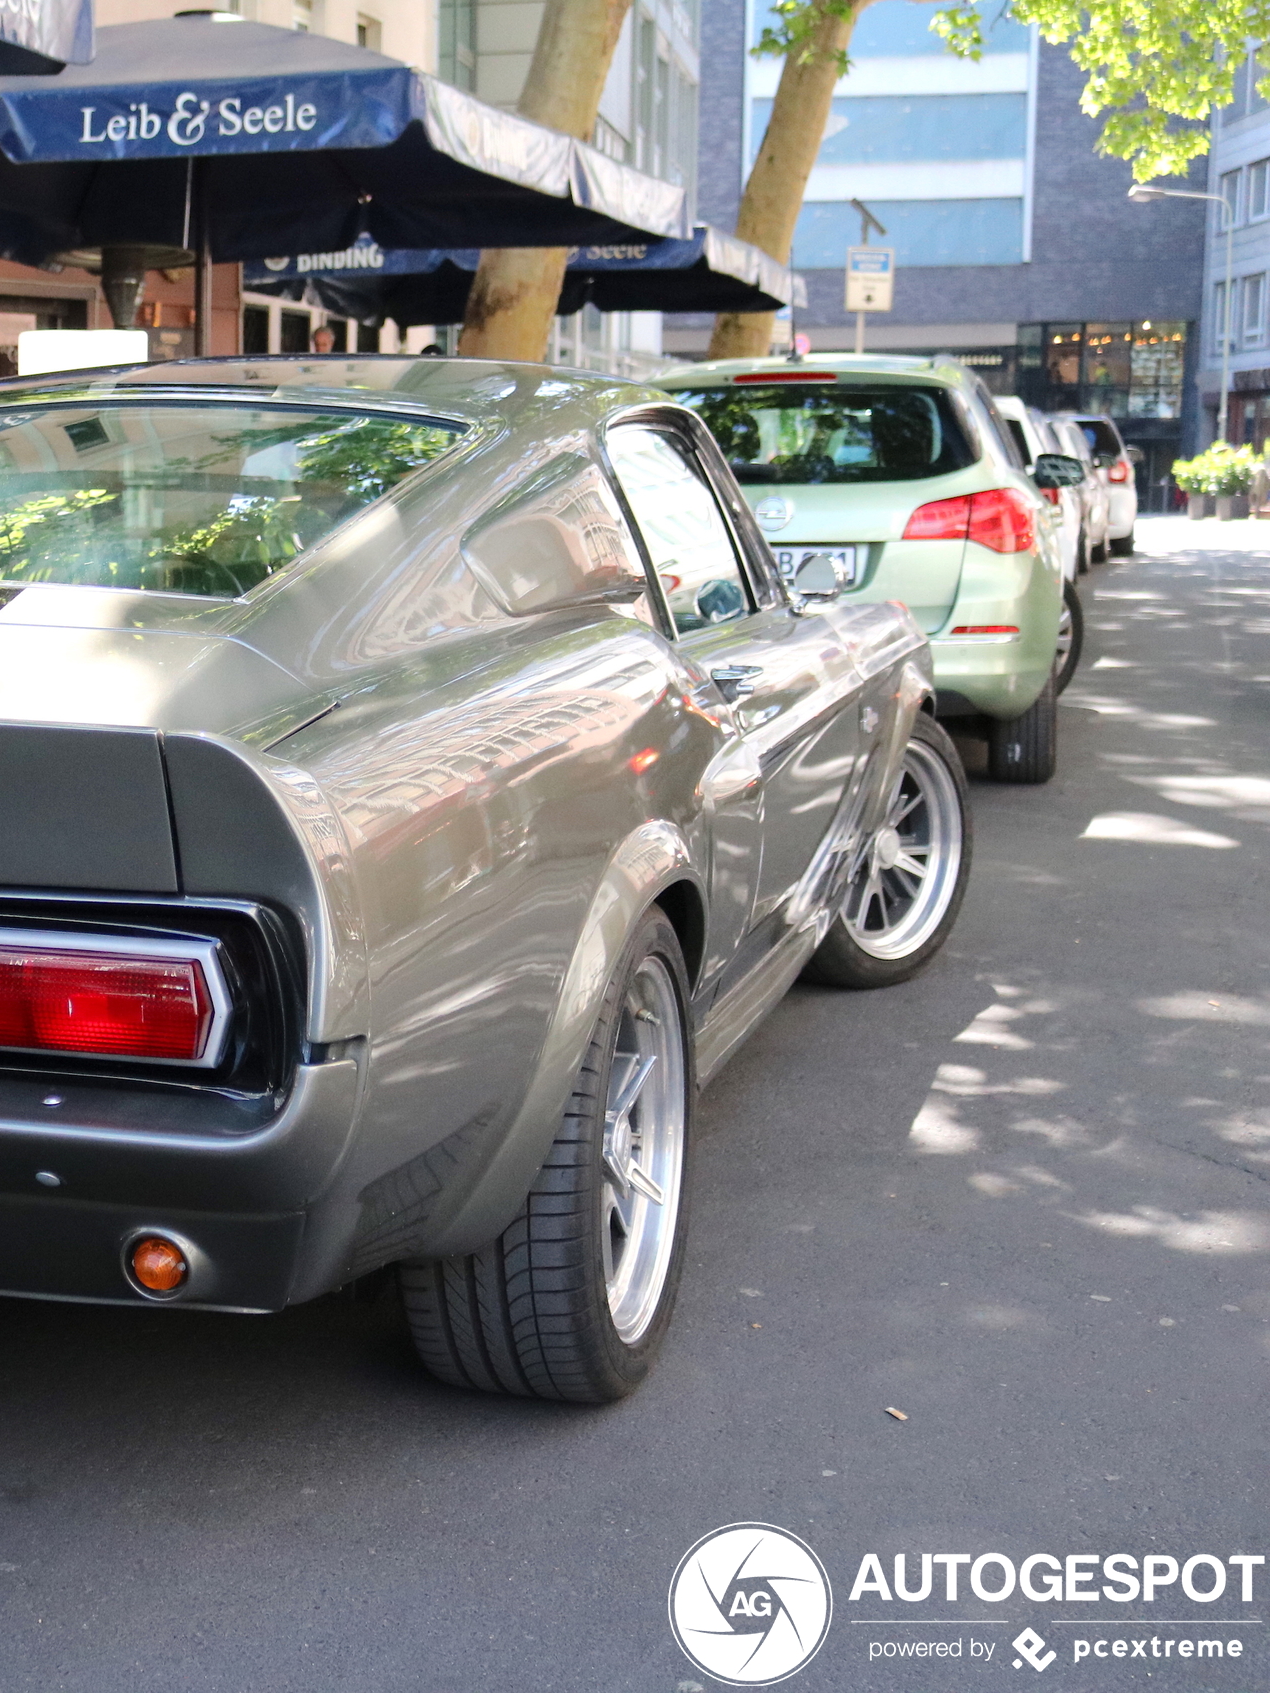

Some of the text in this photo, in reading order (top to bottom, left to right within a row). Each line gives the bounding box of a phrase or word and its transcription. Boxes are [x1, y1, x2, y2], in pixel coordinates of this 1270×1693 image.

[79, 92, 318, 146] Leib & Seele
